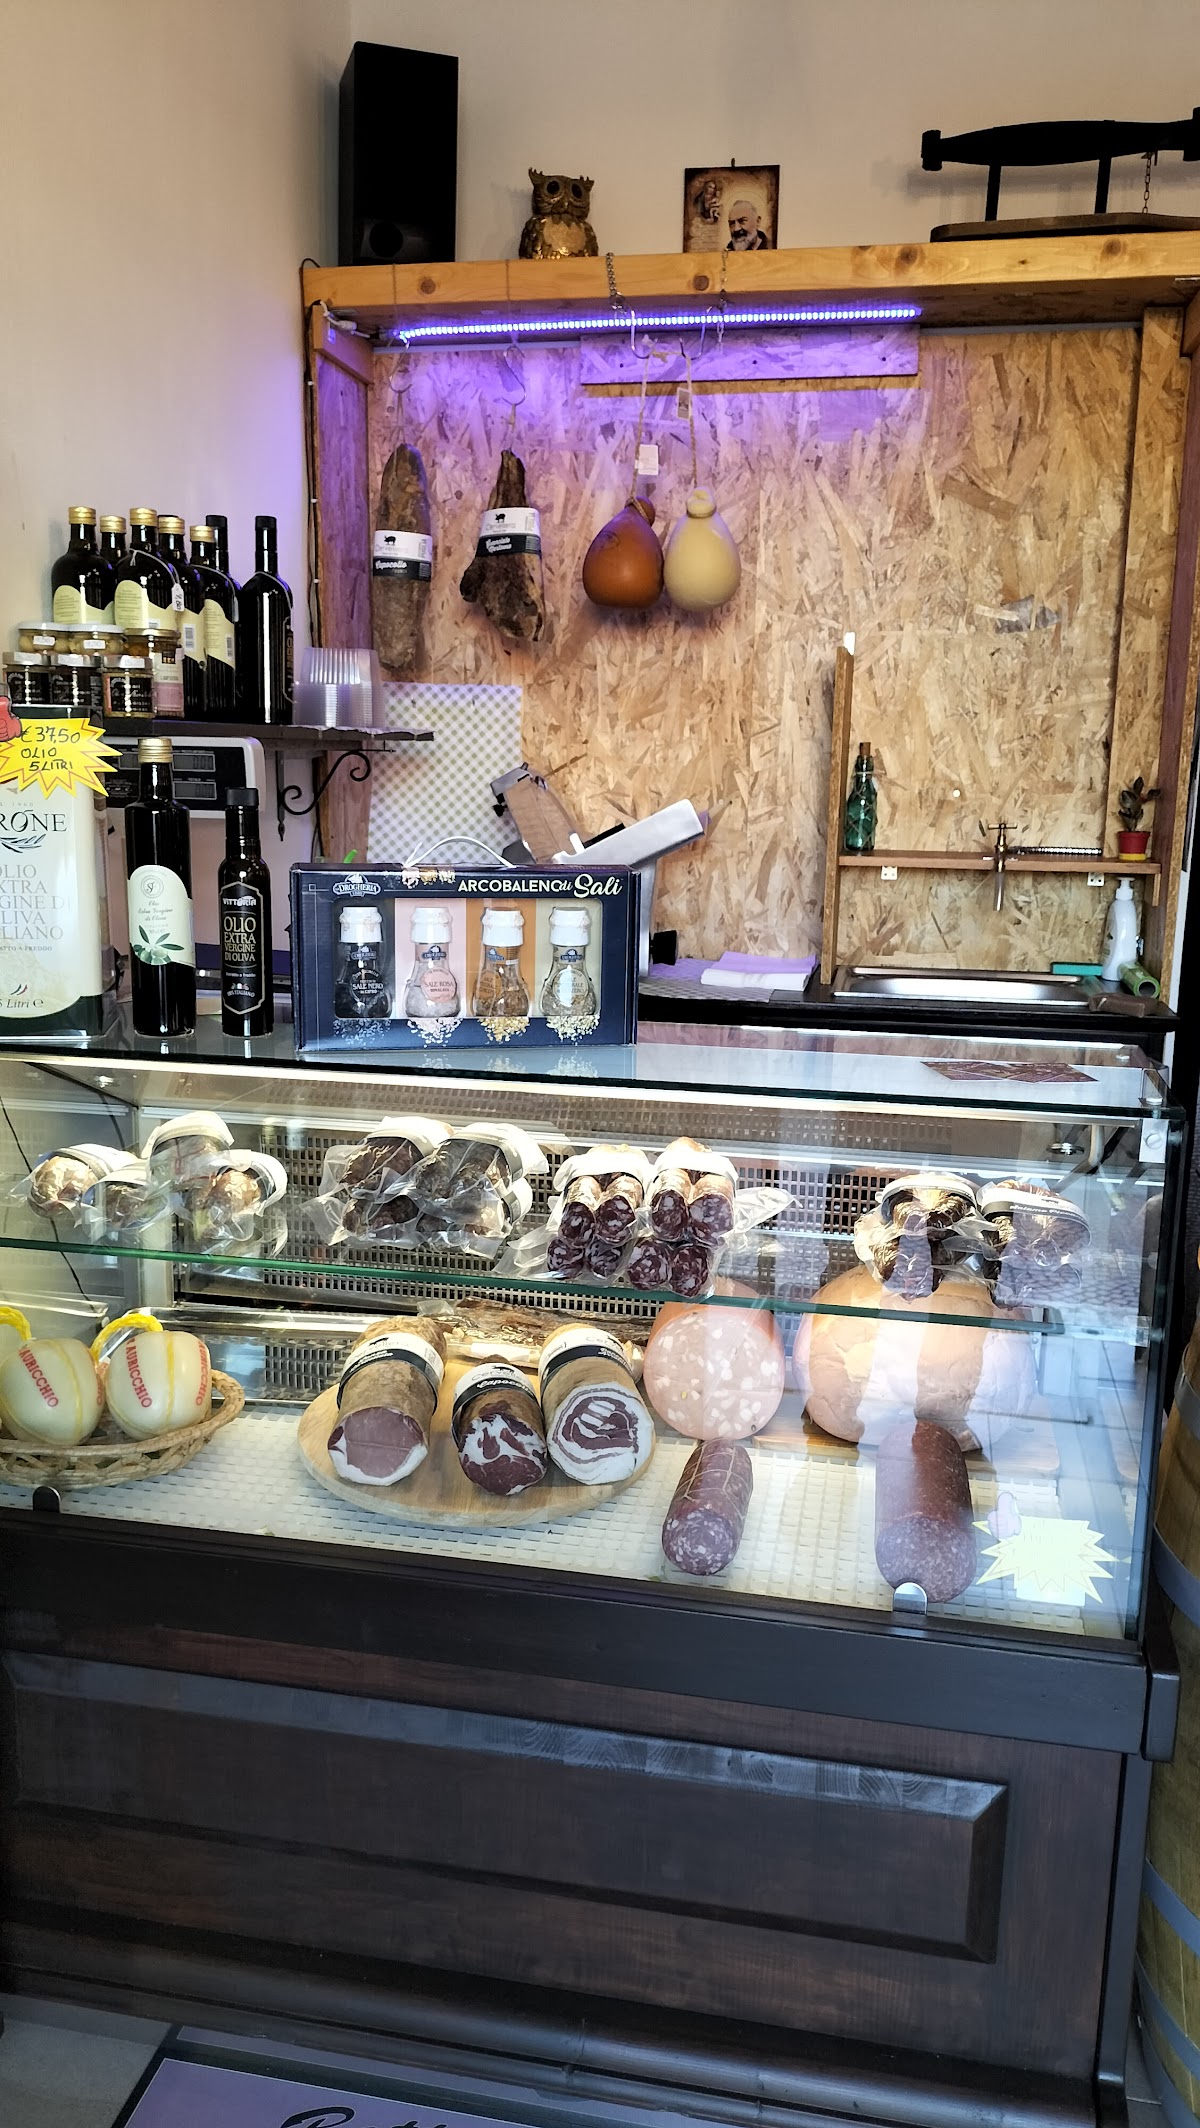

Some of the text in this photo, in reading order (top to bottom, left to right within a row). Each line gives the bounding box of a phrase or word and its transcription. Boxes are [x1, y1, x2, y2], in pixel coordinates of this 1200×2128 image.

[21, 747, 57, 758] OLIO
[338, 883, 377, 893] DROGHERIA
[573, 873, 621, 898] Sali
[223, 896, 257, 907] VITTORIA
[223, 916, 256, 932] OLIO
[224, 932, 256, 944] EXTRA
[224, 943, 256, 952] VERGINE
[225, 952, 256, 961] DI OLIVA
[368, 982, 383, 990] NERO
[7, 999, 30, 1008] Litri
[18, 1348, 59, 1407] AURICCHIO
[126, 1345, 153, 1408] AURICCHIO
